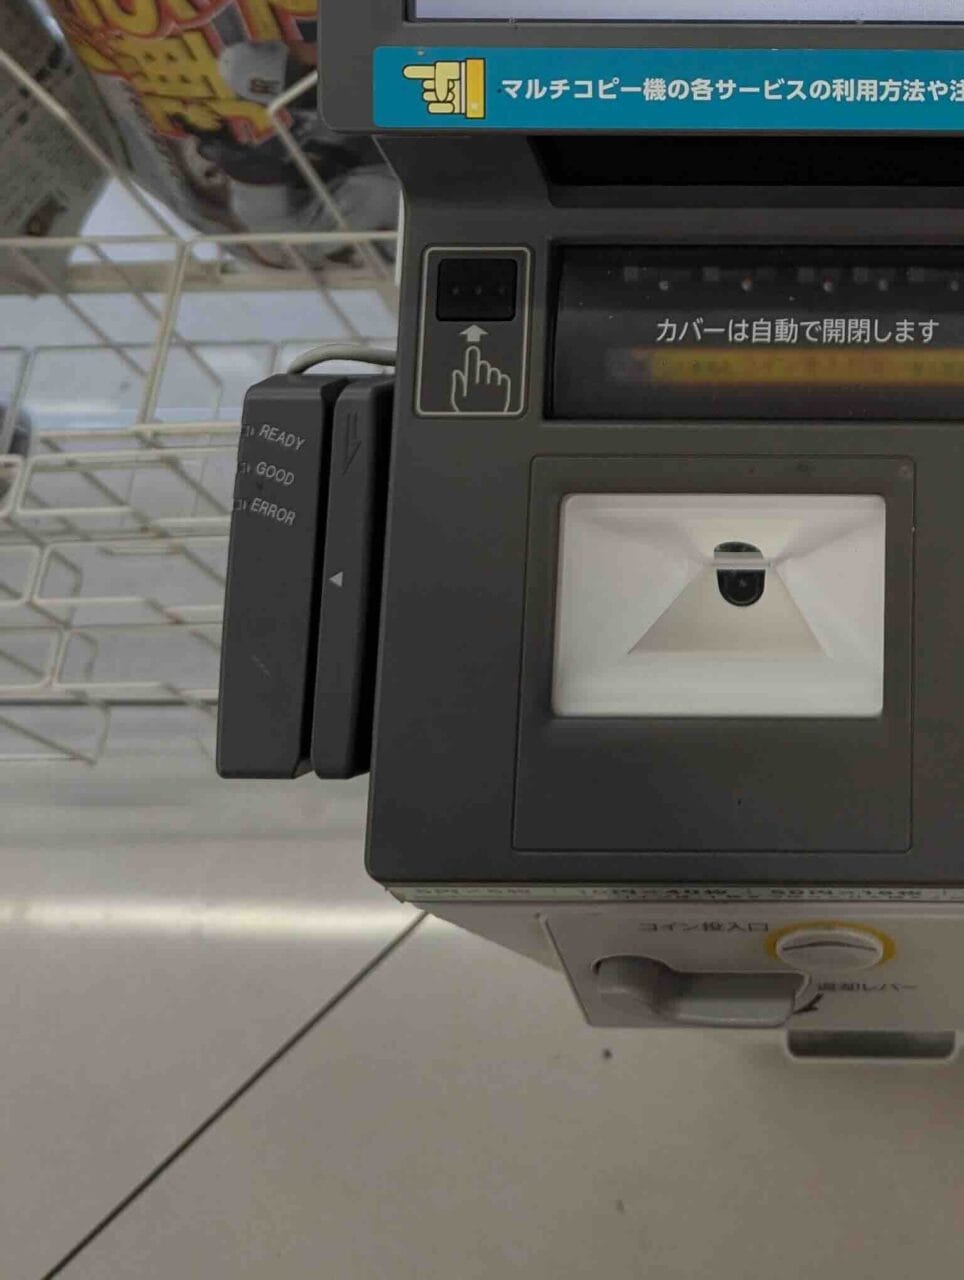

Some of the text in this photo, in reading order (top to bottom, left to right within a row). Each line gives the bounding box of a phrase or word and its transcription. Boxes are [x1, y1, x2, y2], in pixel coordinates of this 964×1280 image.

[656, 317, 941, 345] カバーは自動で開閉します
[258, 424, 306, 451] READY
[255, 461, 296, 487] GOOD
[250, 497, 297, 526] ERROR
